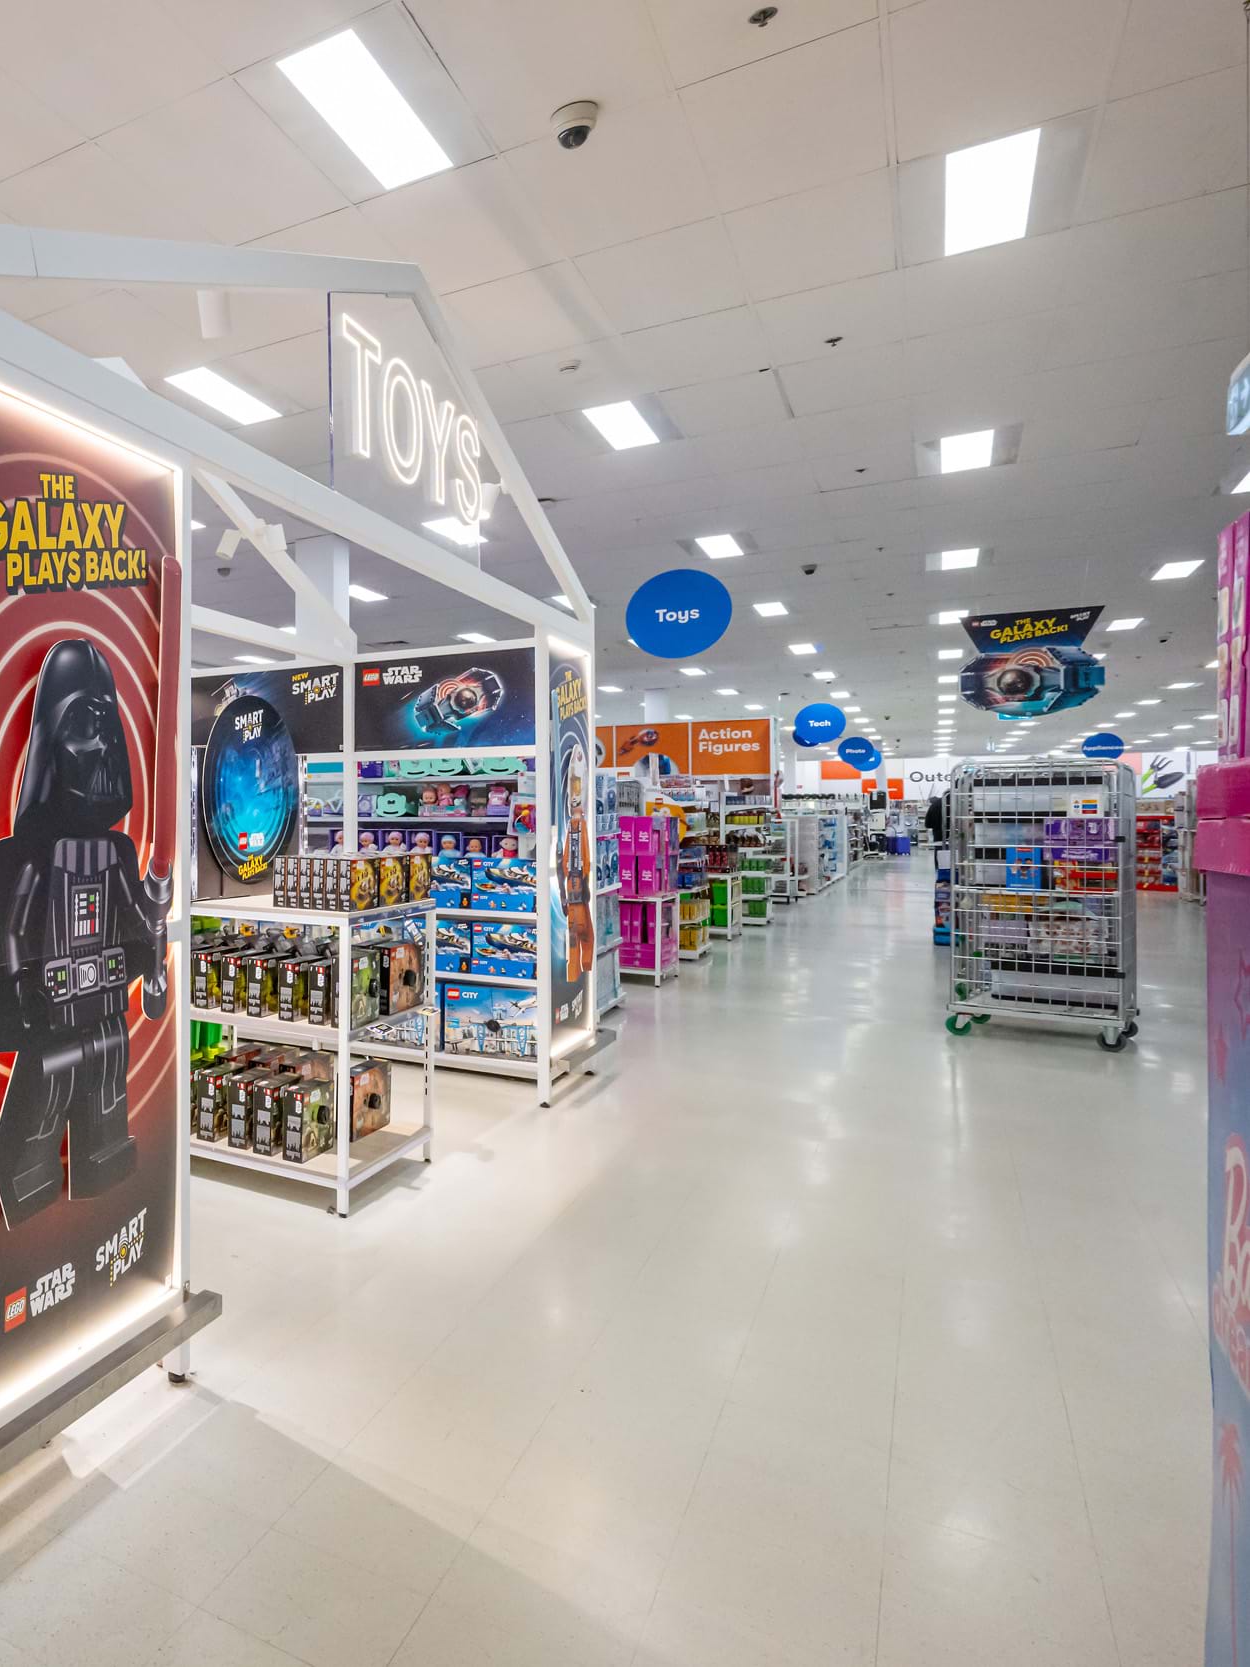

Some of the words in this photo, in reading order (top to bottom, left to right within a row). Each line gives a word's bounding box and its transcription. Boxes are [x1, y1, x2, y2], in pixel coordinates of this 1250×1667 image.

[342, 312, 483, 526] TOYS
[40, 473, 75, 500] THE
[6, 551, 82, 587] PLAYS
[85, 549, 147, 582] BACK!
[655, 608, 700, 624] Toys
[1015, 617, 1031, 626] THE
[990, 616, 1058, 640] GALAXY
[1000, 631, 1033, 644] PLAYS
[1035, 624, 1069, 638] BACK!
[291, 672, 309, 682] NEW
[382, 665, 422, 678] STAR
[382, 672, 423, 685] WARS
[291, 672, 340, 695] SMART
[307, 687, 336, 704] PLAY
[234, 709, 264, 730] SMART
[808, 719, 831, 728] Tech
[244, 726, 262, 742] PLAY
[698, 727, 753, 740] Action
[699, 741, 761, 755] Figures
[461, 991, 479, 999] CITY
[95, 1207, 147, 1272] SMART
[112, 1237, 144, 1282] PLAY
[30, 1262, 76, 1297] STAR
[30, 1278, 76, 1318] WARS
[6, 1300, 26, 1320] LEGO
